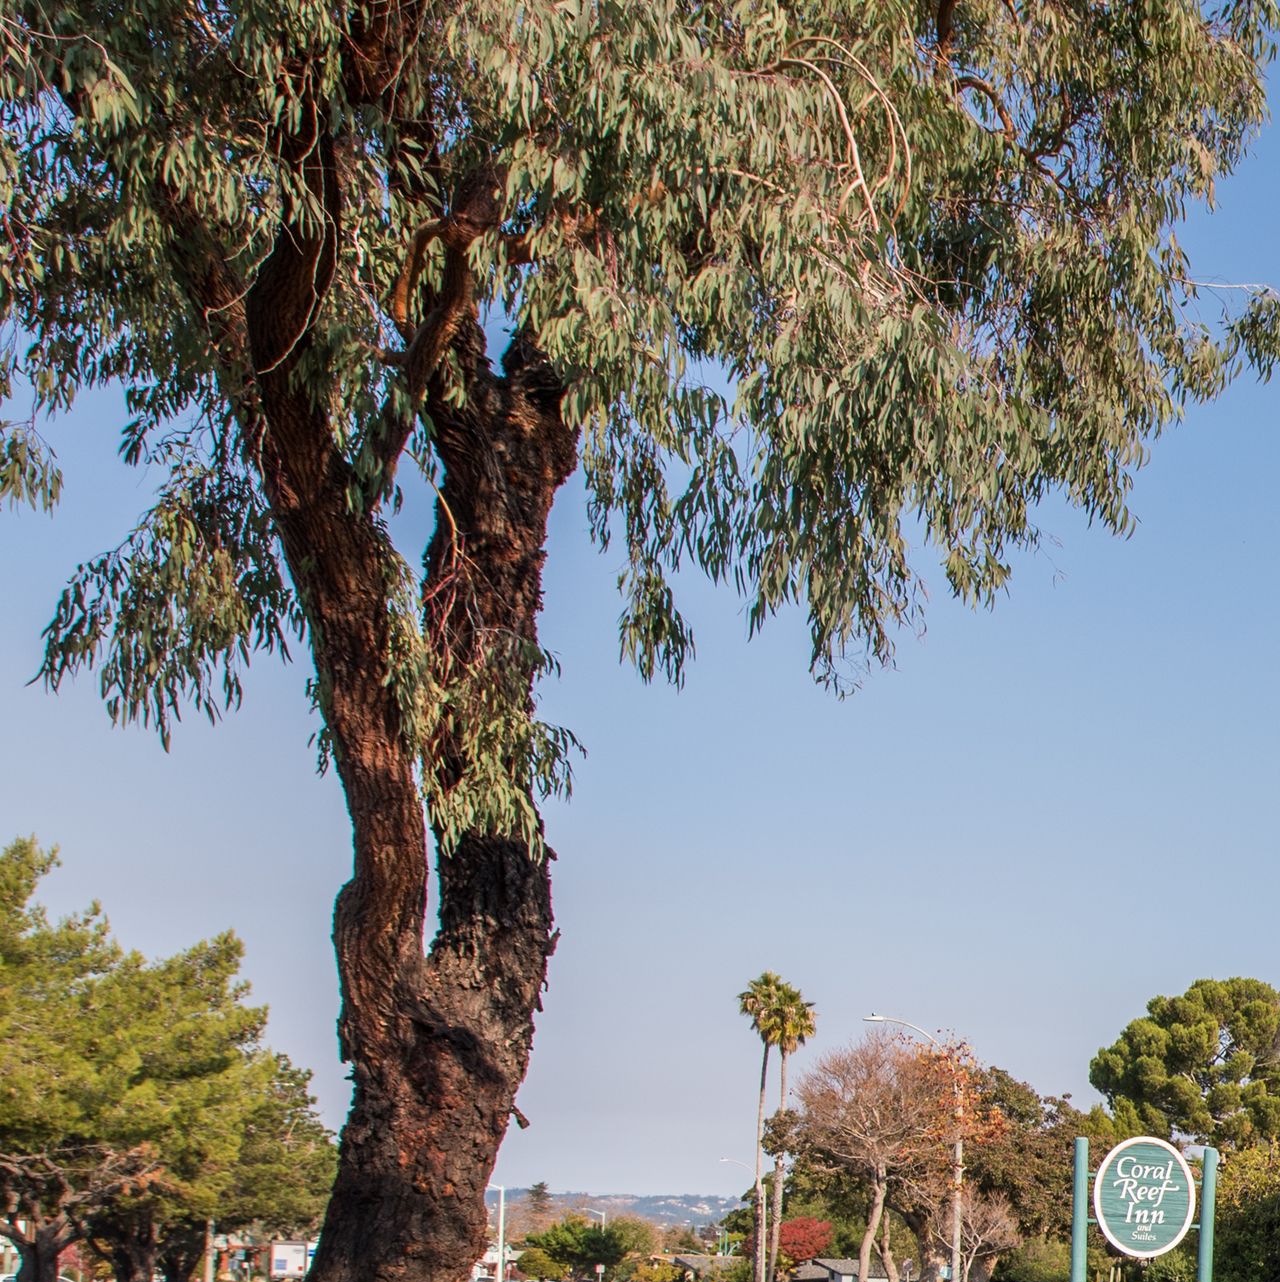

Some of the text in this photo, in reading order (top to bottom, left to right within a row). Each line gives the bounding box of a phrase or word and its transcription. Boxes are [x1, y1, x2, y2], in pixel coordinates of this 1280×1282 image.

[1116, 1156, 1173, 1180] Coral
[1113, 1178, 1180, 1207] Reef
[1125, 1201, 1165, 1225] Inn
[1131, 1231, 1157, 1241] Suites
[1136, 1223, 1152, 1232] and
